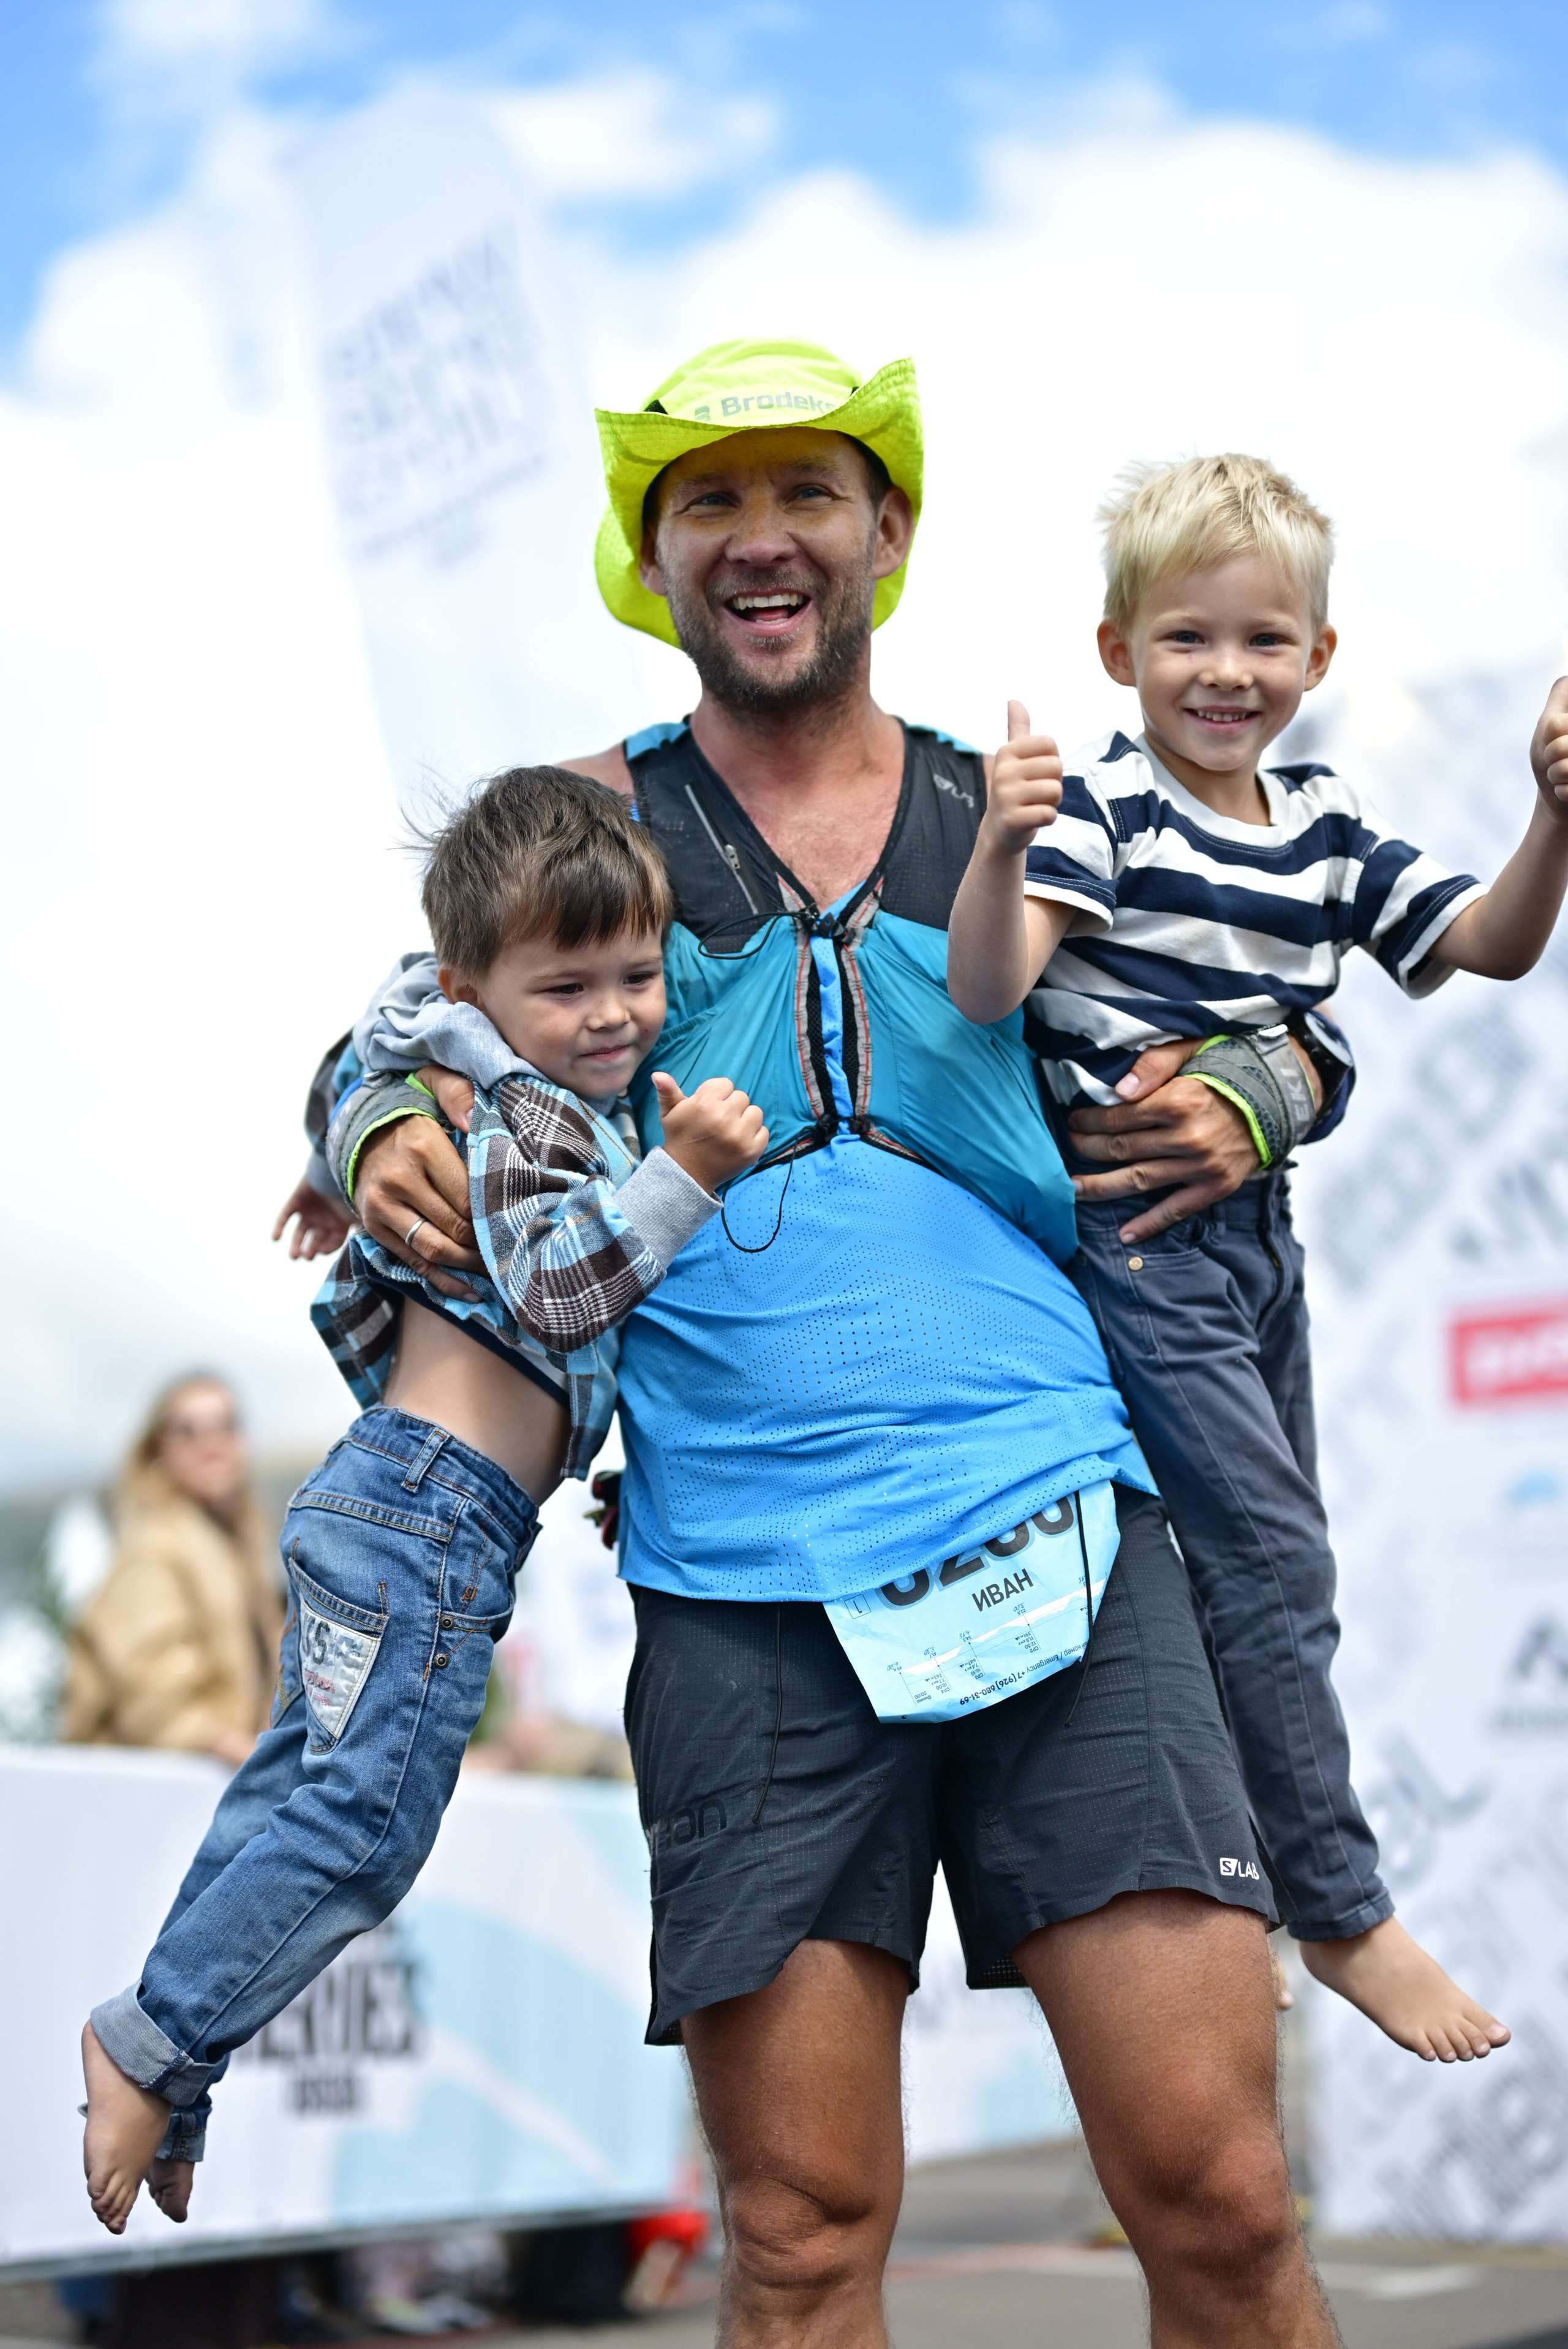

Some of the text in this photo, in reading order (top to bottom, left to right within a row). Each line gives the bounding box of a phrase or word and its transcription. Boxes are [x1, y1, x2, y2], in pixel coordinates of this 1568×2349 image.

[972, 1568, 1034, 1612] ИВАН
[1064, 1644, 1082, 1656] номер
[1027, 1654, 1060, 1673] Emergency
[995, 1673, 1017, 1690] (926)
[960, 1685, 996, 1706] 680-31-69
